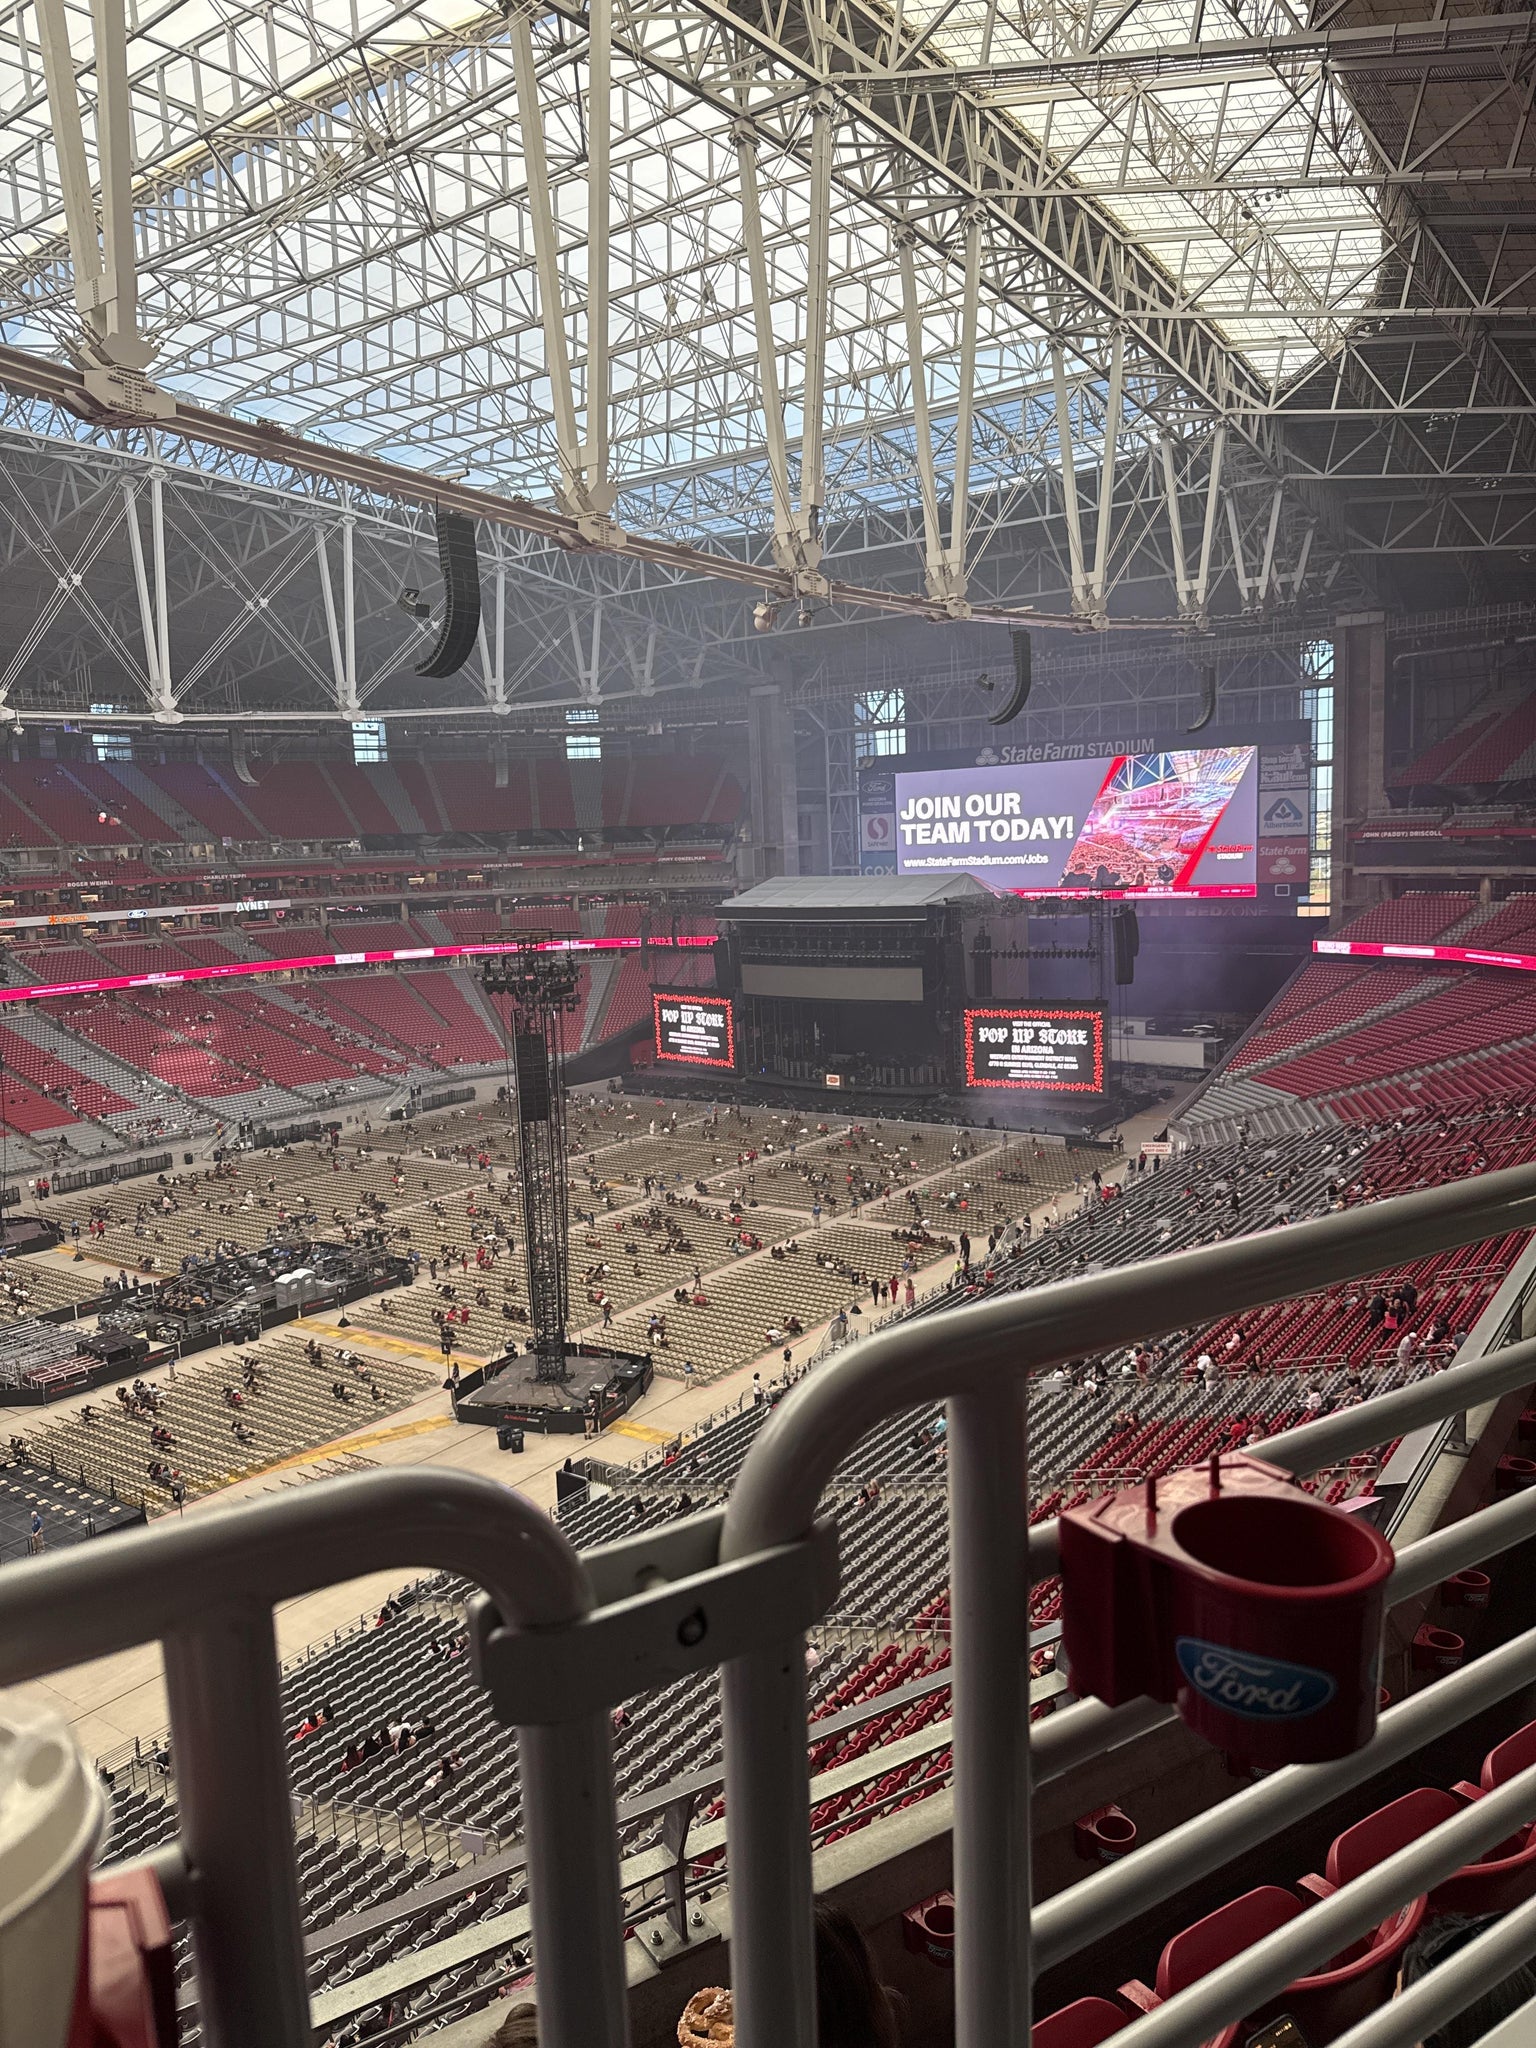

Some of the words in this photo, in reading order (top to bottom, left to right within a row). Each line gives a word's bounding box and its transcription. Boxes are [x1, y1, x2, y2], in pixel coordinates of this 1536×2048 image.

[1087, 738, 1155, 757] STADIUM
[900, 795, 960, 820] JOIN
[965, 792, 1021, 817] OUR
[900, 820, 970, 845] TEAM
[973, 815, 1074, 843] TODAY!
[1263, 820, 1303, 830] Albertsons
[864, 865, 895, 876] COX
[236, 900, 270, 913] AVNET
[662, 1009, 679, 1023] POP
[681, 1010, 694, 1024] UP
[695, 1012, 724, 1027] STORE
[979, 1027, 1008, 1043] POP
[1012, 1028, 1034, 1043] UP
[1039, 1029, 1088, 1045] STORE
[1011, 1045, 1020, 1053] IN
[1021, 1045, 1054, 1054] ARIZONA
[1193, 1652, 1302, 1711] Ford
